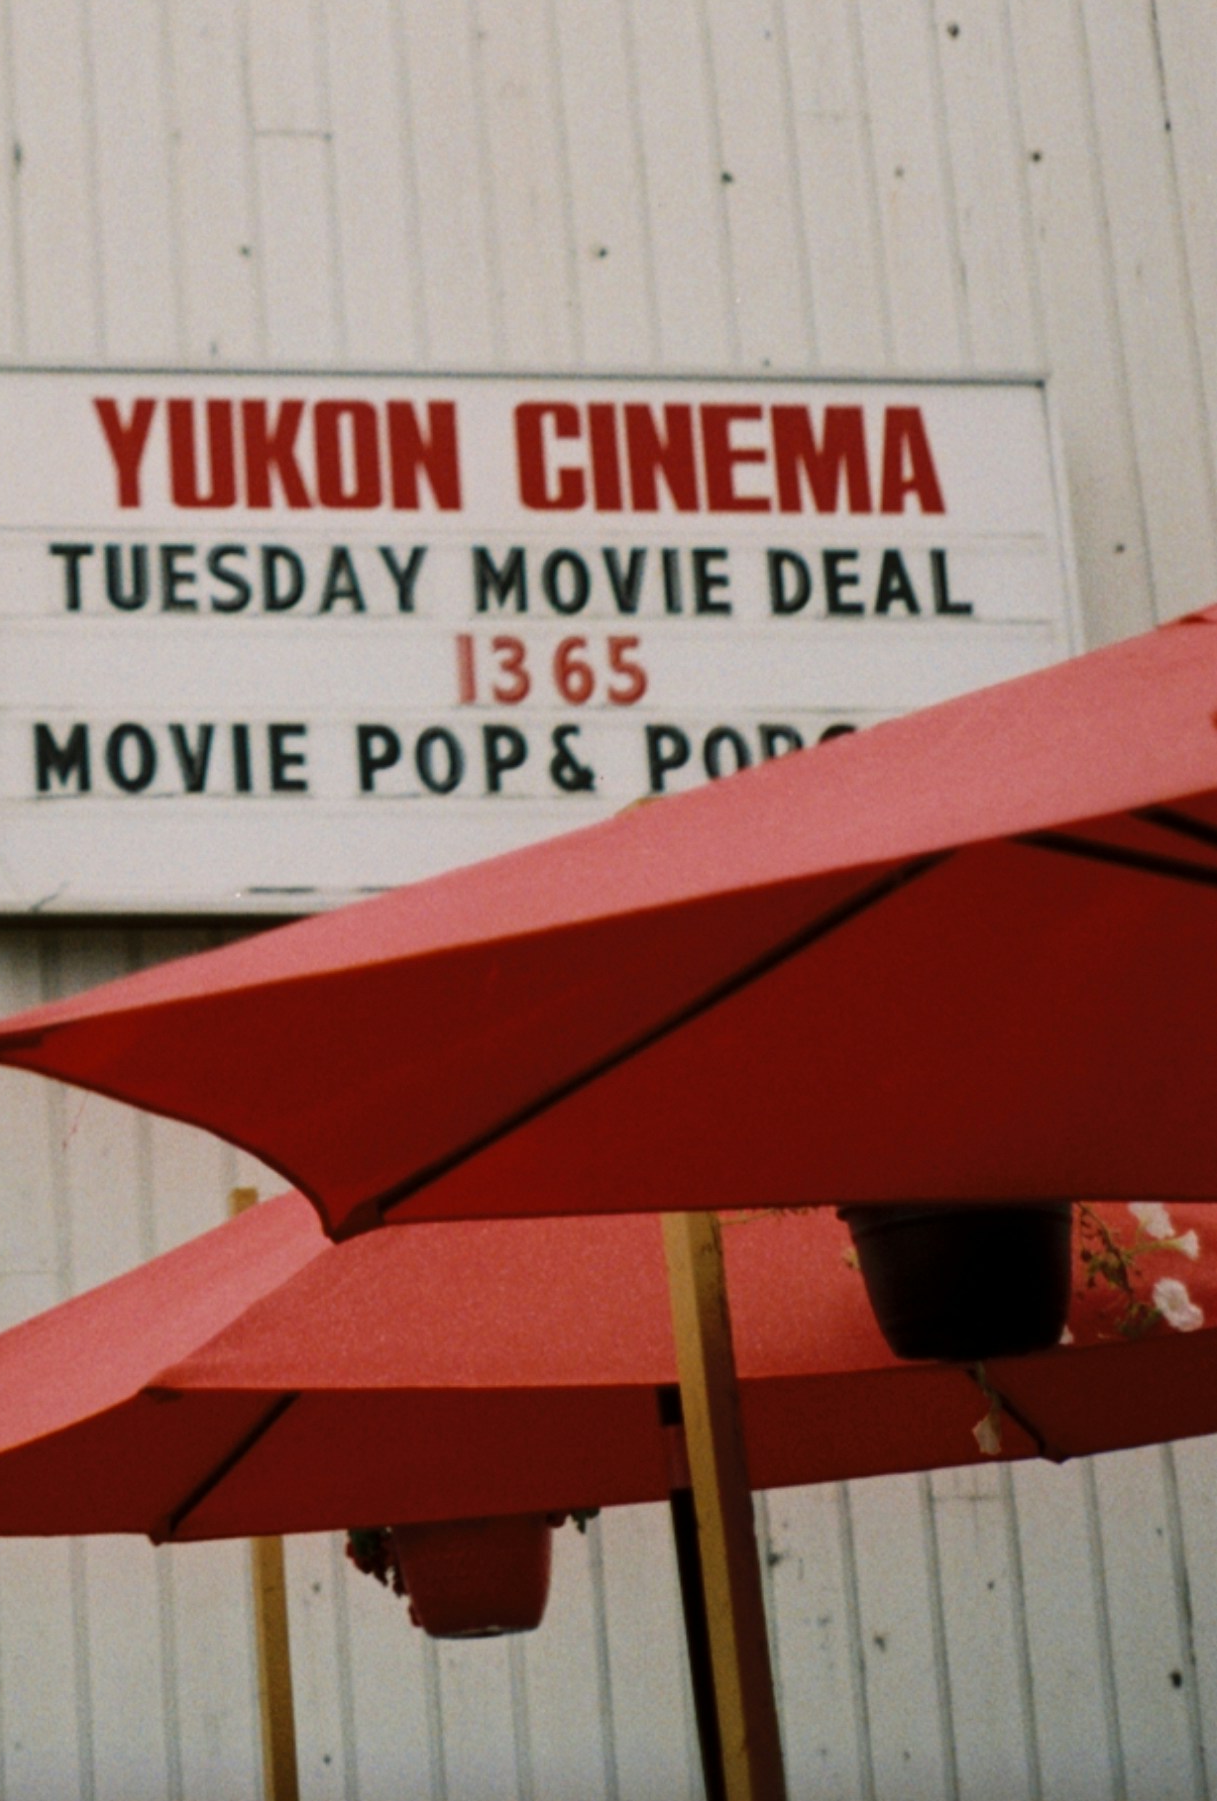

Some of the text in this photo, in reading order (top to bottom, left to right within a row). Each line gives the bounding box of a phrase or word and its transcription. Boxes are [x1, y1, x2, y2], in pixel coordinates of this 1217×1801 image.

[93, 397, 946, 516] YUKON CINEMA
[48, 542, 975, 616] TUESDAY MOVIE DEAL
[455, 633, 648, 706] 1365
[33, 721, 309, 794] MOVIE
[644, 722, 858, 794] POP
